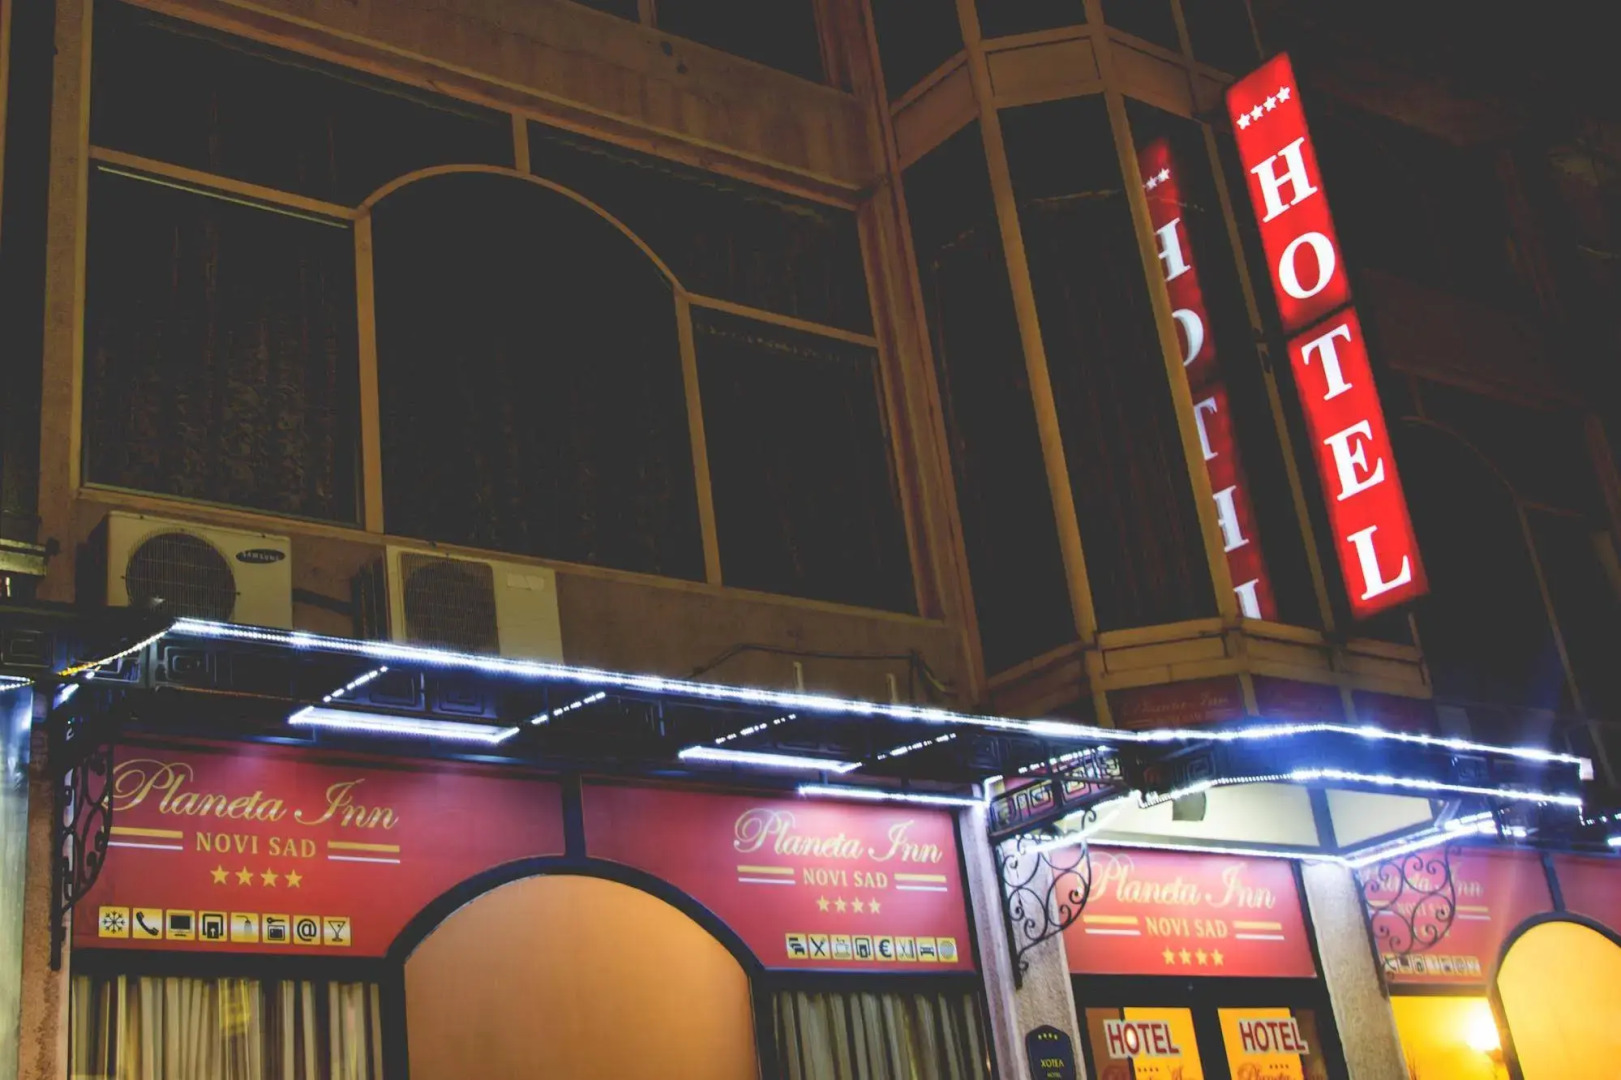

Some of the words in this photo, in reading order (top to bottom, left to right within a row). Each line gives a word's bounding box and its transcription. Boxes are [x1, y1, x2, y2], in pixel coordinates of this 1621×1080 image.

[1250, 136, 1412, 602] HOTEL
[101, 758, 286, 822] Planeta
[294, 778, 399, 829] Inn
[196, 832, 259, 855] NOVI
[269, 837, 317, 858] SAD
[734, 808, 864, 859] Planeta
[868, 820, 943, 863] Inn
[803, 868, 849, 887] NOVI
[853, 871, 888, 889] SAD
[1077, 851, 1204, 907] Planeta
[1204, 862, 1276, 909] Inn
[1145, 916, 1190, 937] NOVI
[1194, 919, 1229, 939] SAD
[1107, 1023, 1180, 1055] HOTEL
[1239, 1021, 1306, 1051] HOTEL
